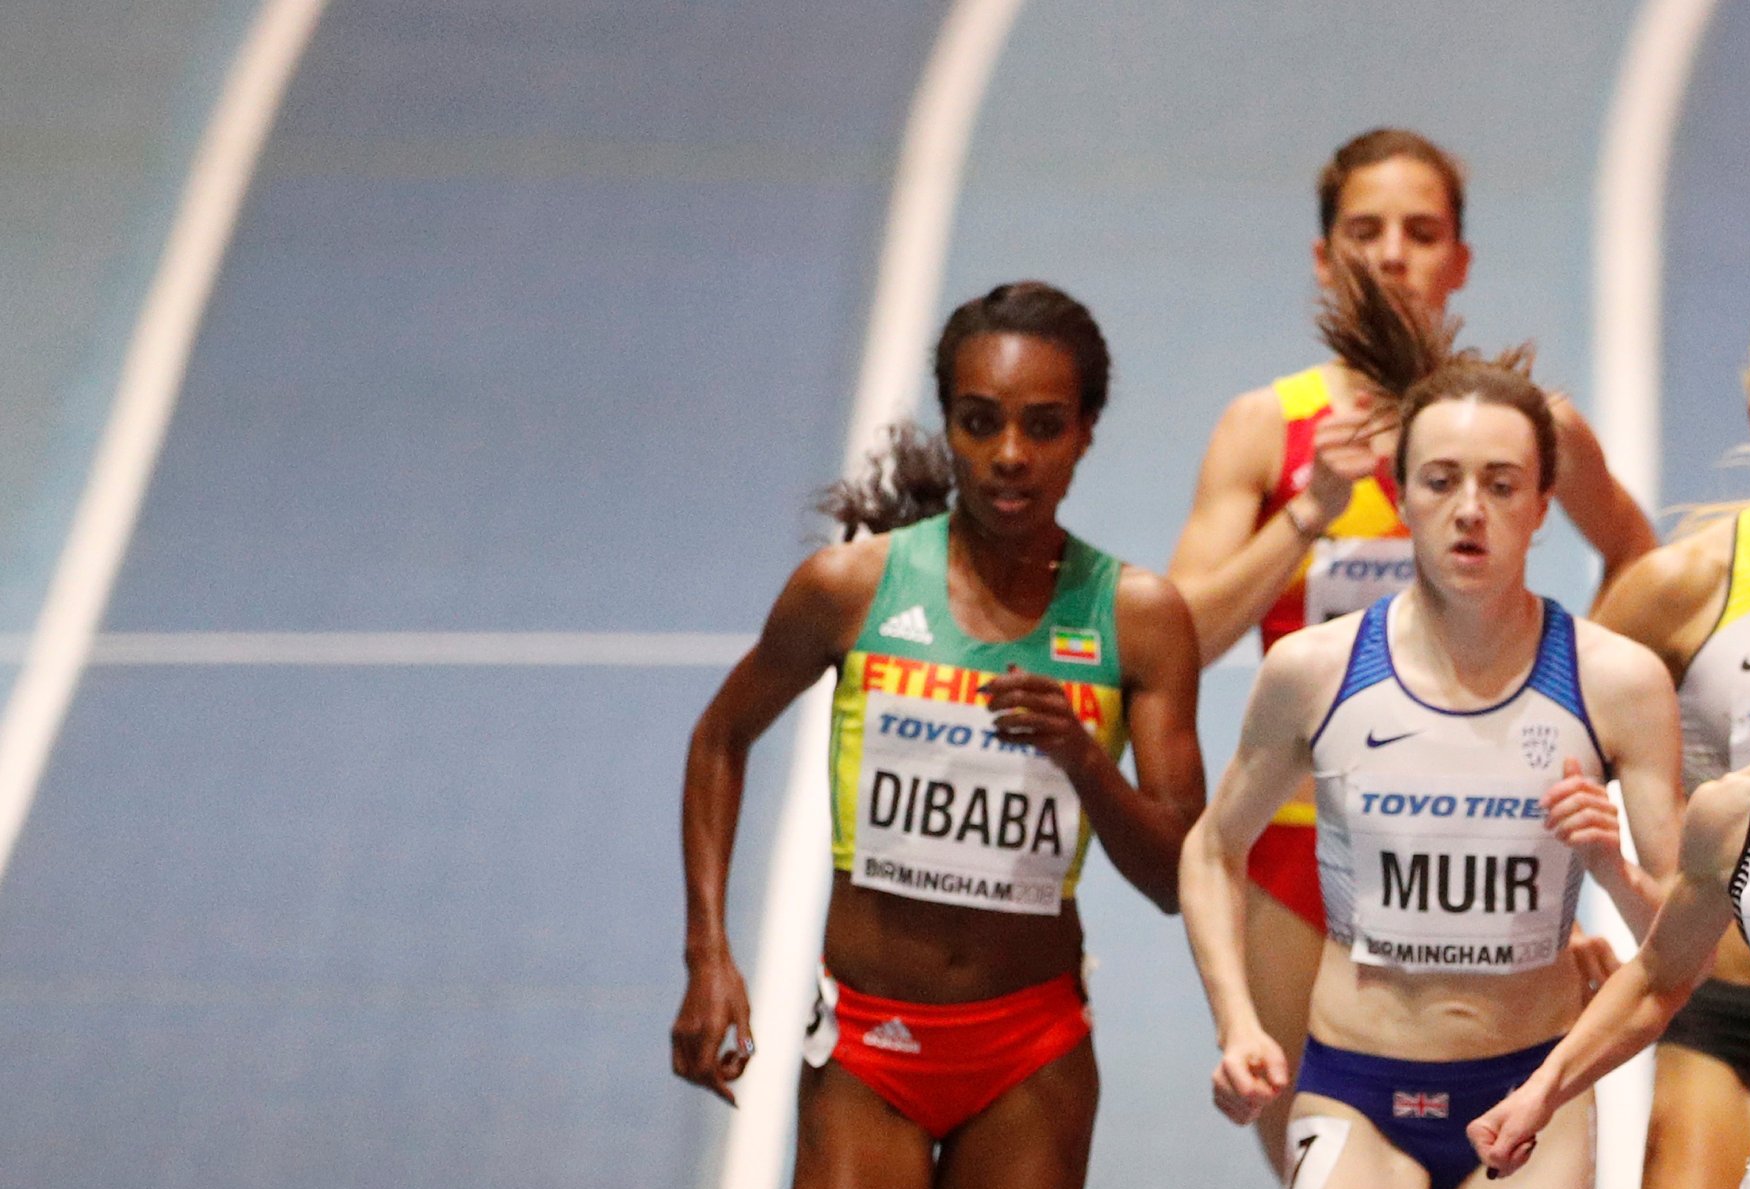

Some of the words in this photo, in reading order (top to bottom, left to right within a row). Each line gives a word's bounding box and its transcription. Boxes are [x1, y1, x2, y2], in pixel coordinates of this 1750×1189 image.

[879, 713, 972, 746] TOYO
[869, 768, 1061, 856] DIBABA
[1361, 793, 1457, 817] TOYO
[1464, 797, 1549, 821] TIRE
[1380, 850, 1540, 914] MUIR
